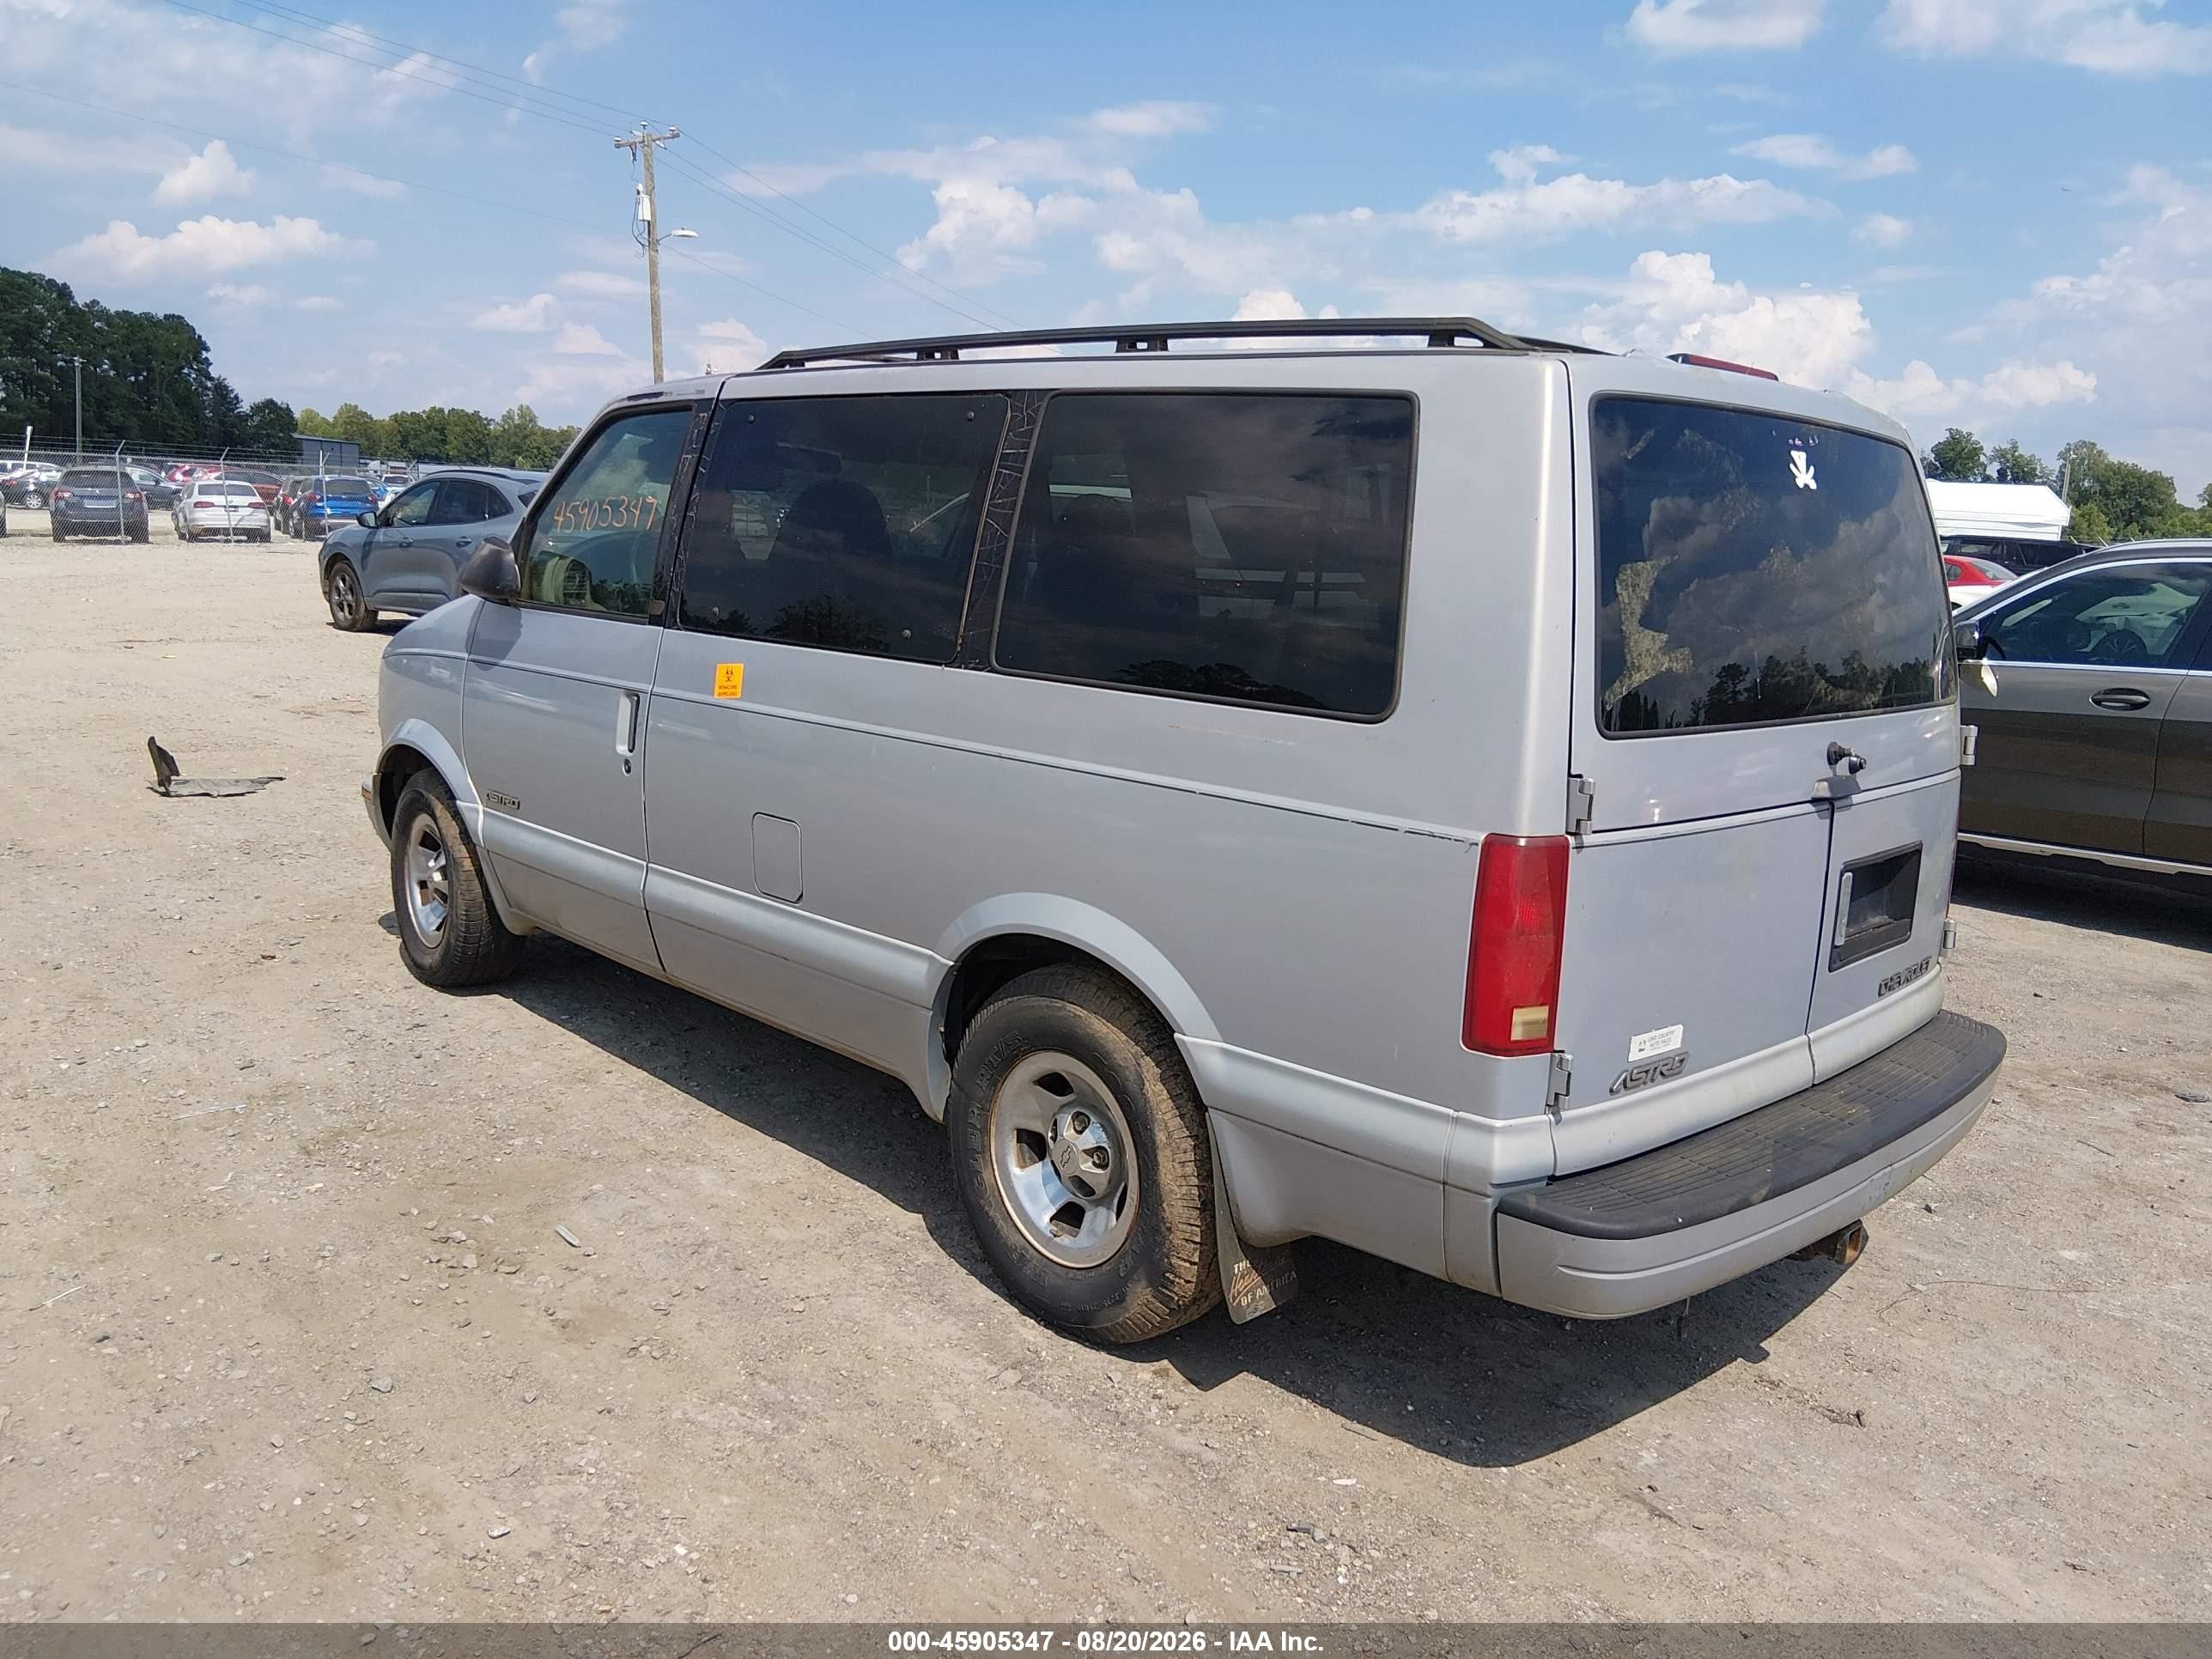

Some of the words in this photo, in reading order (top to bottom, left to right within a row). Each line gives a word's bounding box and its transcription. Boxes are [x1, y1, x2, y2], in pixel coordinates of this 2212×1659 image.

[554, 495, 658, 534] 45905347
[486, 789, 520, 810] ASTRO
[1878, 956, 1932, 998] CHEVROLET
[1609, 1051, 1689, 1097] ASTRO
[1240, 1291, 1254, 1306] OF
